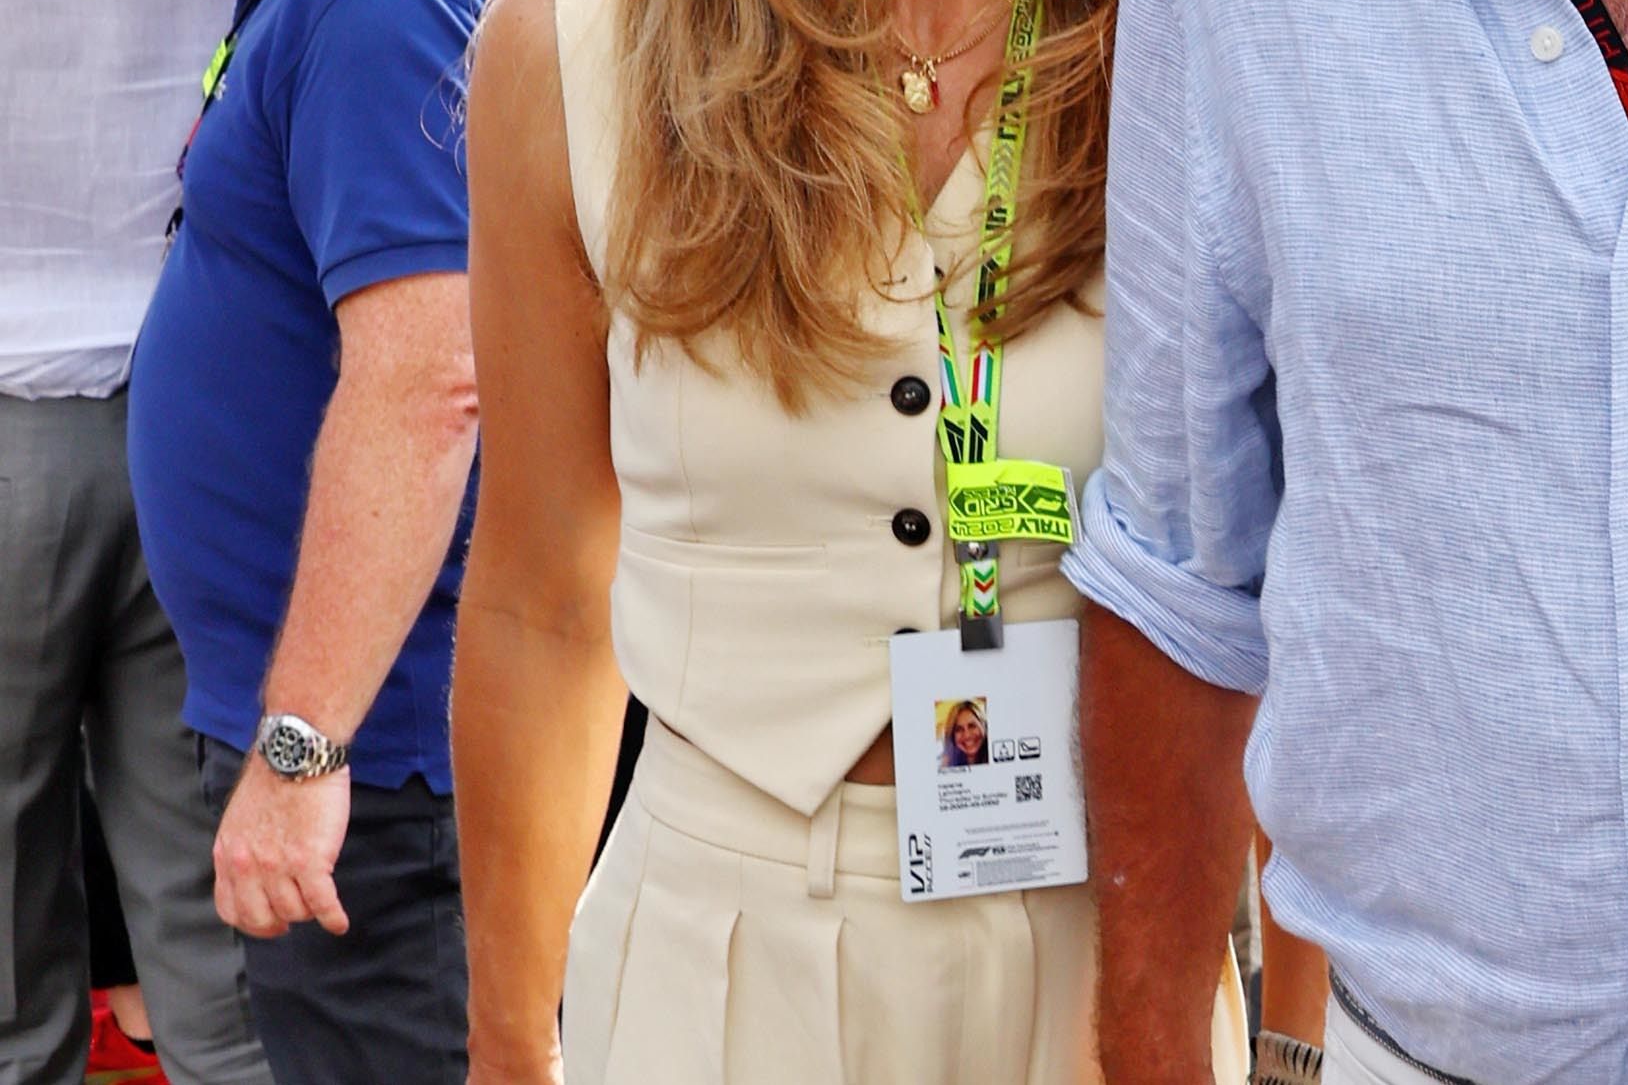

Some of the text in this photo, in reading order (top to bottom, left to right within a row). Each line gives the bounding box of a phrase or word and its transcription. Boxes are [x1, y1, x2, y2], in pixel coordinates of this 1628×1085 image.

[963, 495, 1019, 516] GRID
[951, 516, 1070, 538] ITALY 2024
[909, 834, 925, 893] VIP
